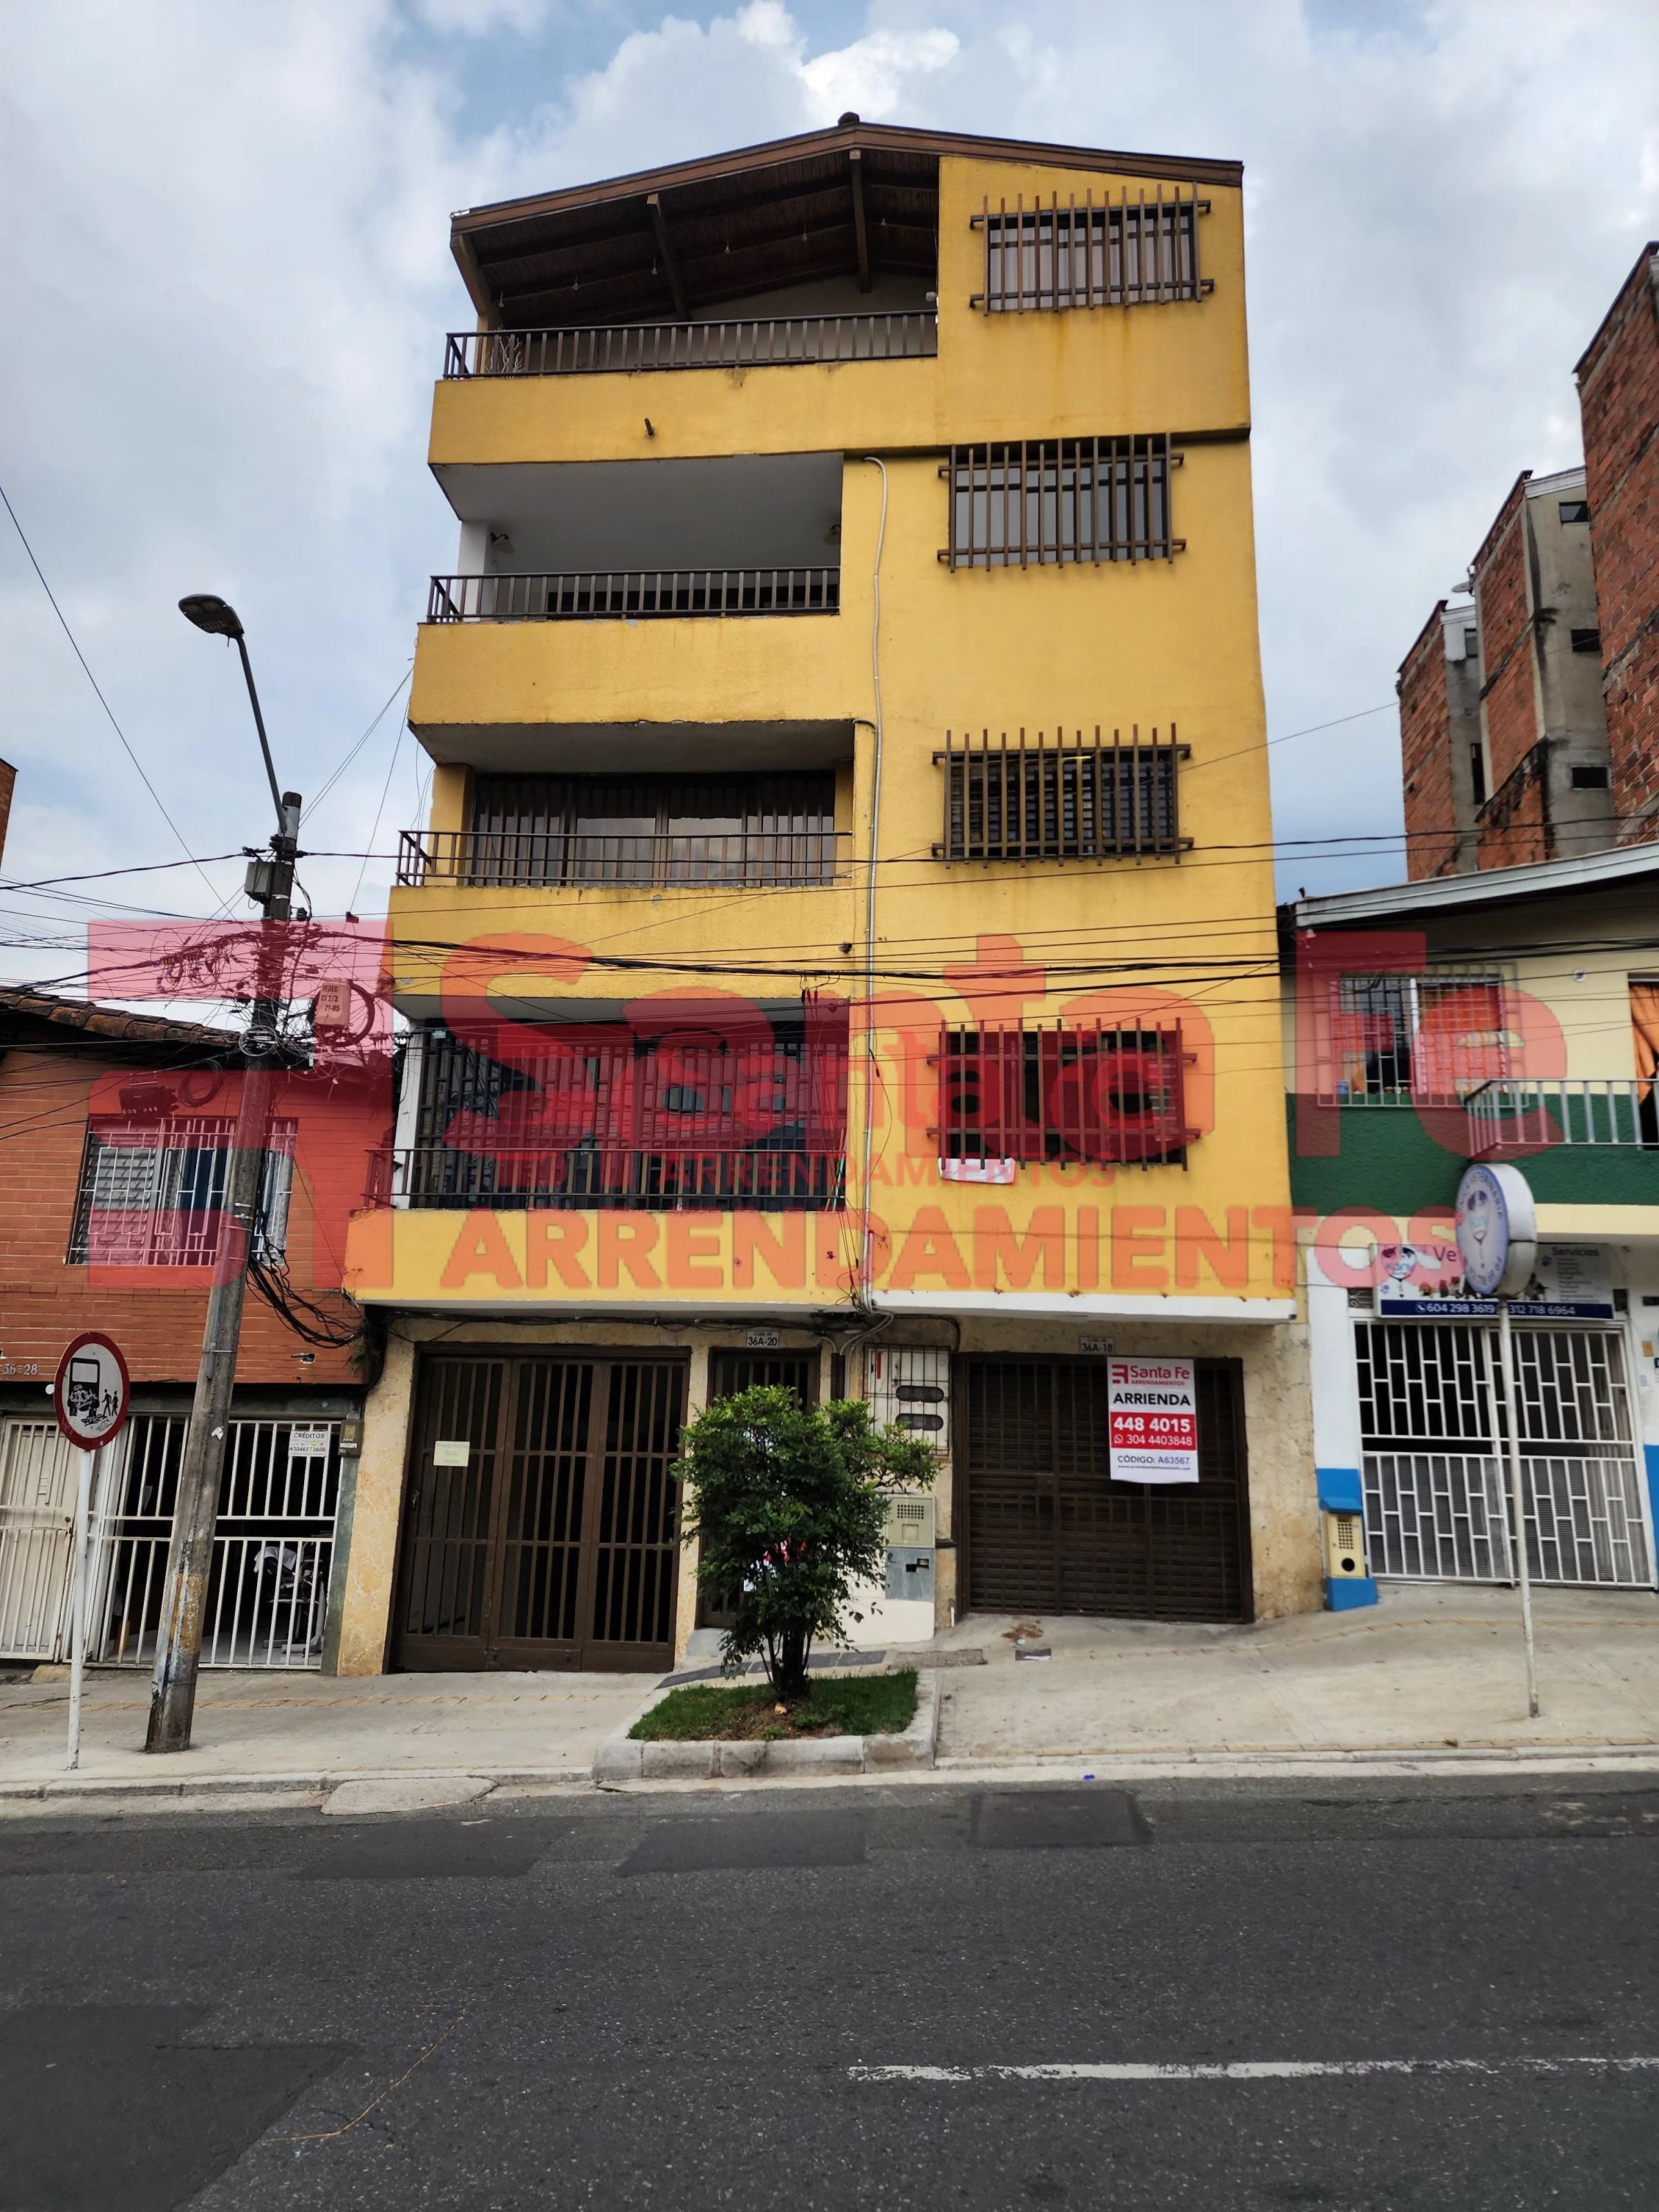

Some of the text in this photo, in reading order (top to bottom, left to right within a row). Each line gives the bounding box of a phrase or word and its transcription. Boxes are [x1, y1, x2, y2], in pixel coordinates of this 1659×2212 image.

[1550, 1246, 1600, 1257] Servicios
[1426, 1303, 1448, 1313] 604
[1450, 1304, 1470, 1313] 298
[747, 1336, 778, 1346] 36A-20
[1082, 1342, 1113, 1353] 36A-18
[1130, 1365, 1190, 1380] Santa Fe
[1113, 1392, 1191, 1406] ARRIENDA
[1113, 1416, 1191, 1433] 448 4015
[1126, 1434, 1192, 1446] 304 4403848
[1117, 1454, 1190, 1465] CÓDIGO: A63567
